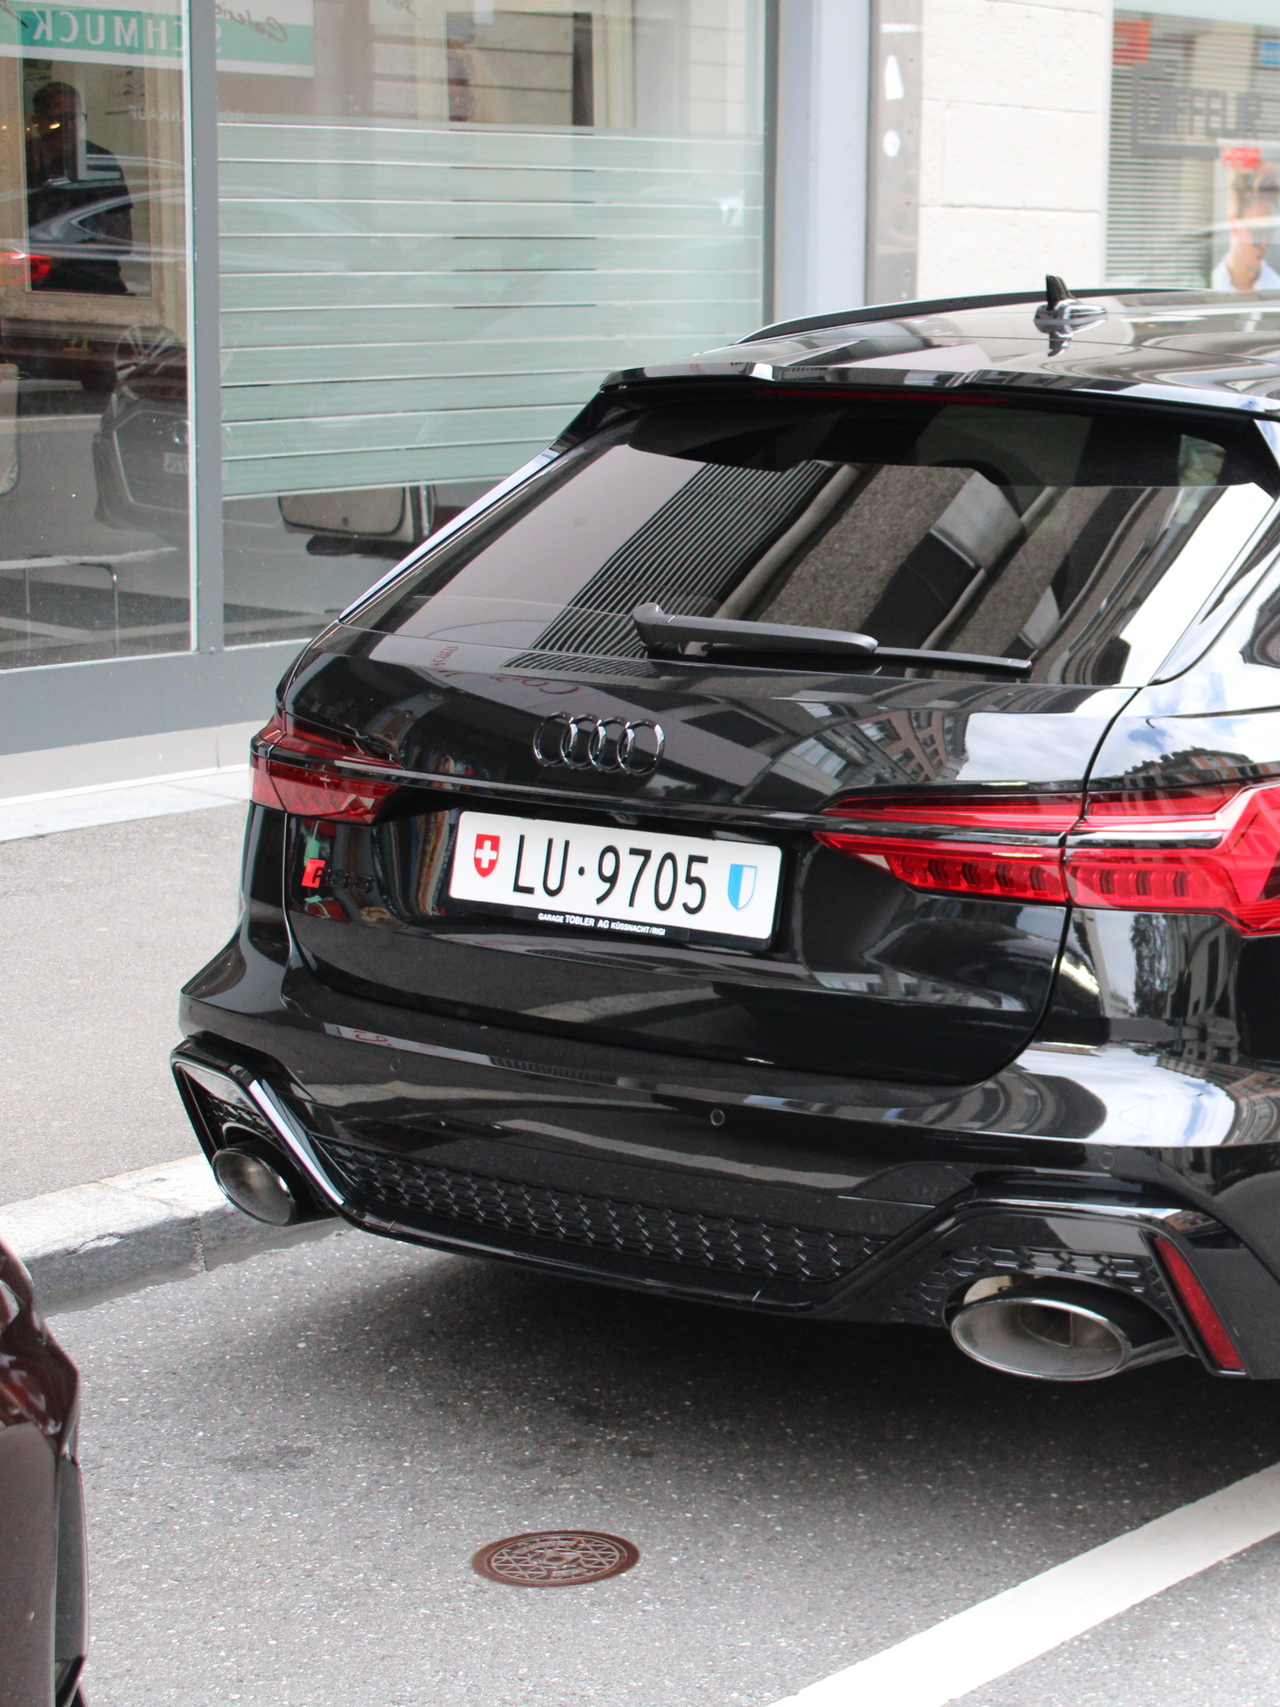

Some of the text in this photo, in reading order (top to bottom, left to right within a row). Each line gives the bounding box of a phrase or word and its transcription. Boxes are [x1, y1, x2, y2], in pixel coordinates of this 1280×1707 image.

[538, 912, 564, 924] GARAGE
[565, 914, 595, 927] TOBLER
[597, 918, 610, 929] AG
